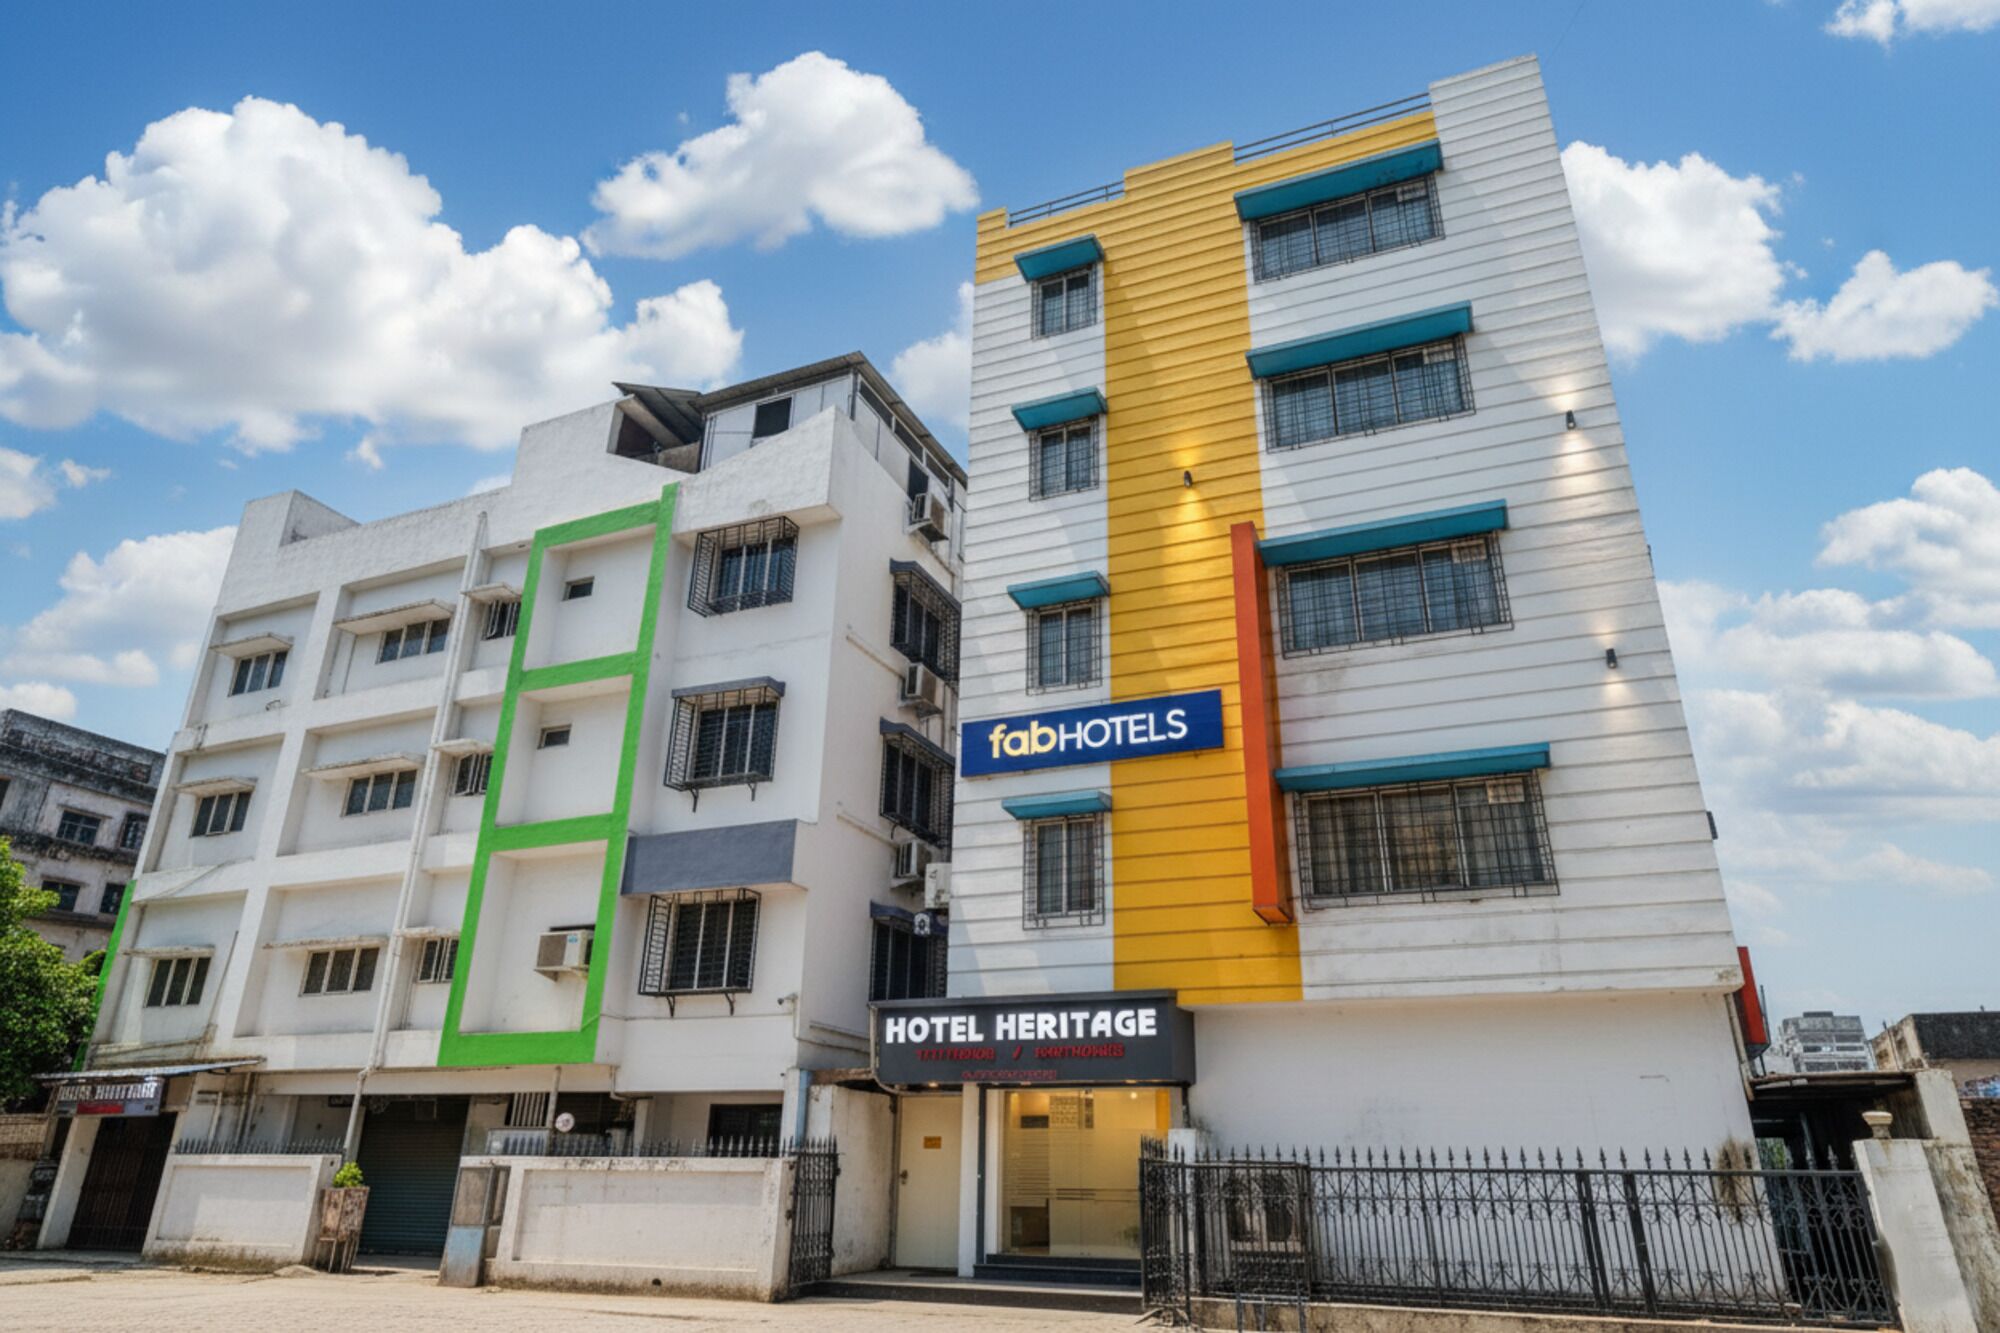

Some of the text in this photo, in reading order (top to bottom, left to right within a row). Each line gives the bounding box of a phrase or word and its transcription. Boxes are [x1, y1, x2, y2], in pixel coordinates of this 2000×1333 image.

[988, 709, 1188, 759] fabHOTELS
[885, 1008, 1157, 1044] HOTEL HERITAGE
